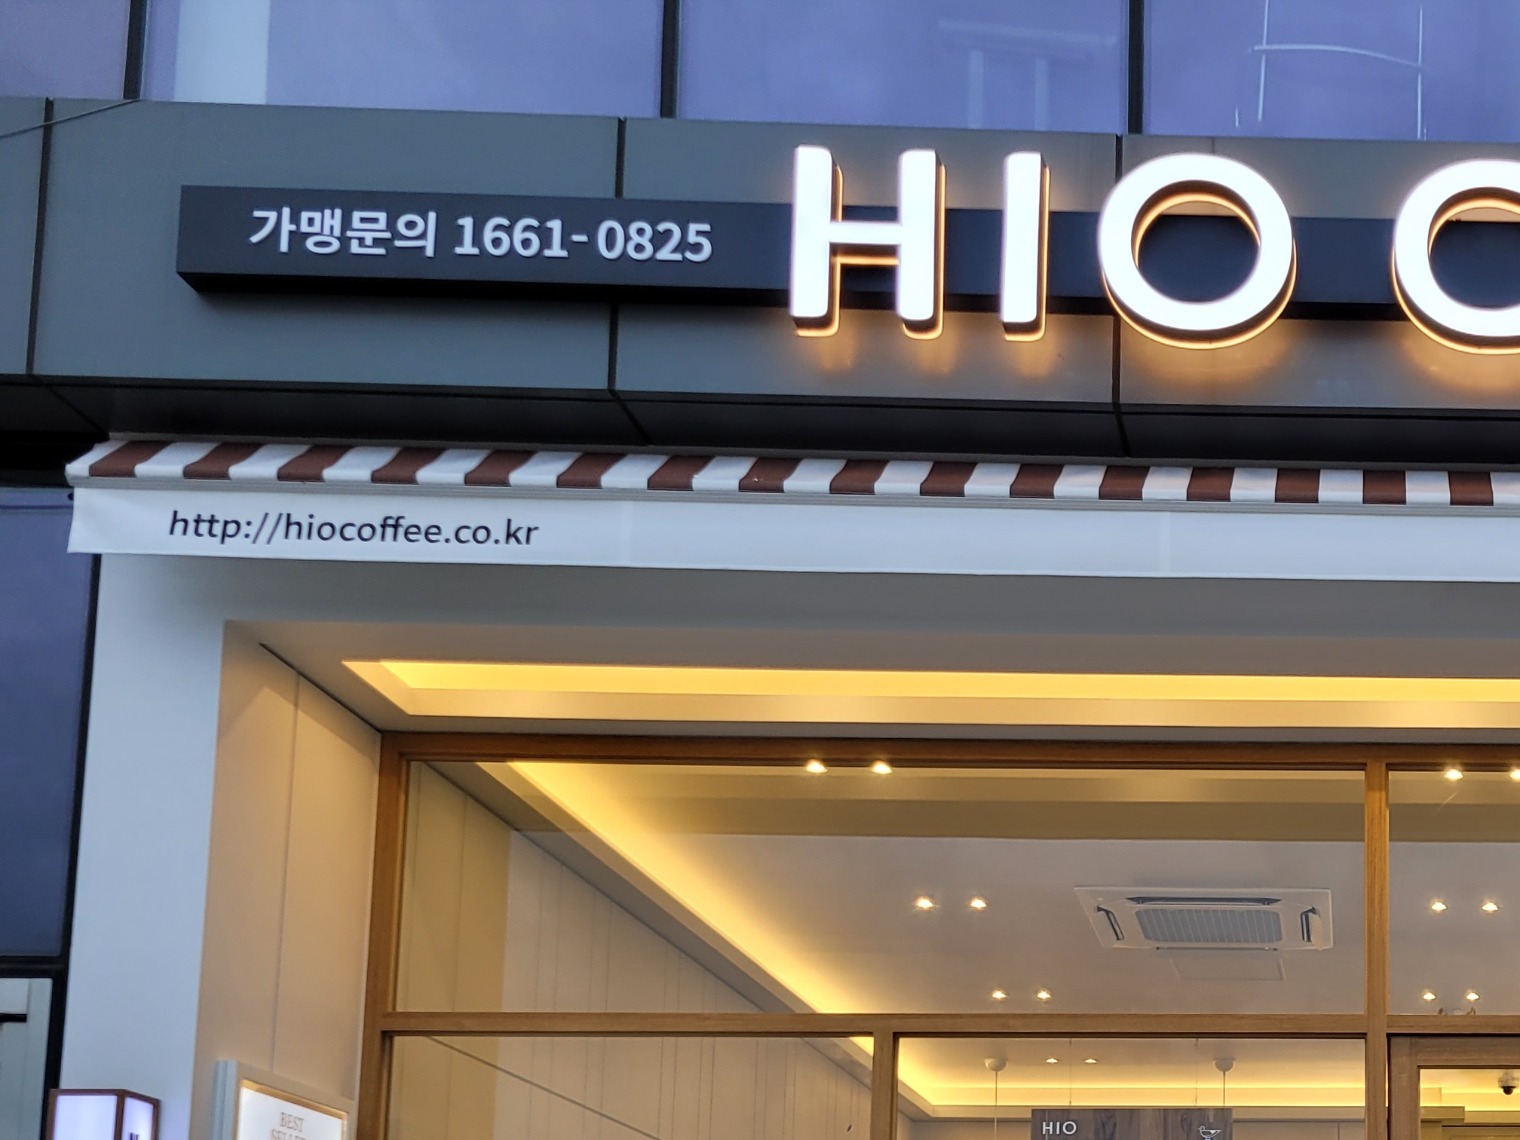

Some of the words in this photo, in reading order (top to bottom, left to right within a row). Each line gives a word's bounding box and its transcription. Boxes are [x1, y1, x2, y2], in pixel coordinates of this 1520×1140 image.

[249, 205, 438, 258] 가맹문의
[453, 214, 714, 264] 1661-0825
[789, 145, 1296, 349] HIO
[168, 510, 539, 547] http://hiocoffee.co.kr
[279, 1110, 305, 1133] BEST
[1042, 1120, 1077, 1135] HIO
